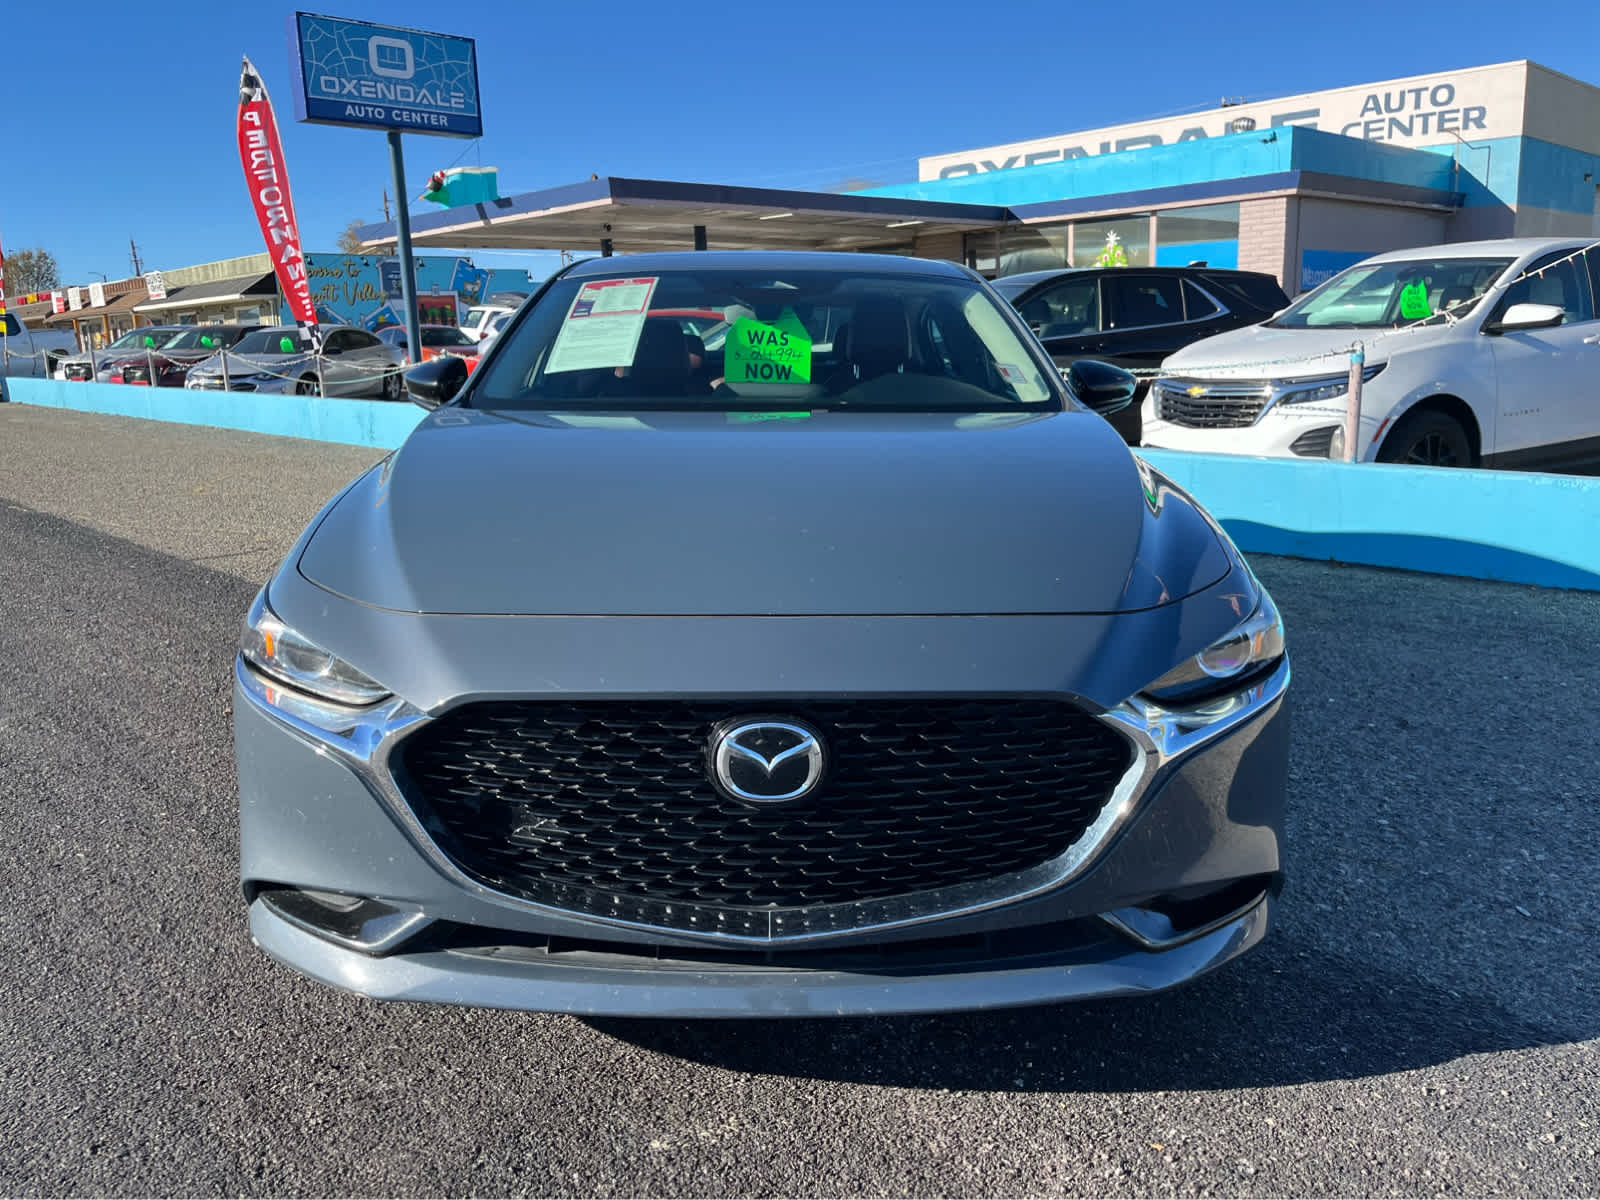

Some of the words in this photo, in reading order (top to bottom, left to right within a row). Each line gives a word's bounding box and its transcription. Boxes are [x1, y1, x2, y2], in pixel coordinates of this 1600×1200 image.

[320, 75, 465, 109] OXENDALE
[1359, 83, 1456, 118] AUTO
[345, 105, 385, 119] AUTO
[391, 110, 449, 127] CENTER
[1340, 105, 1487, 141] CENTER
[747, 329, 789, 346] WAS
[745, 363, 793, 381] NOW
